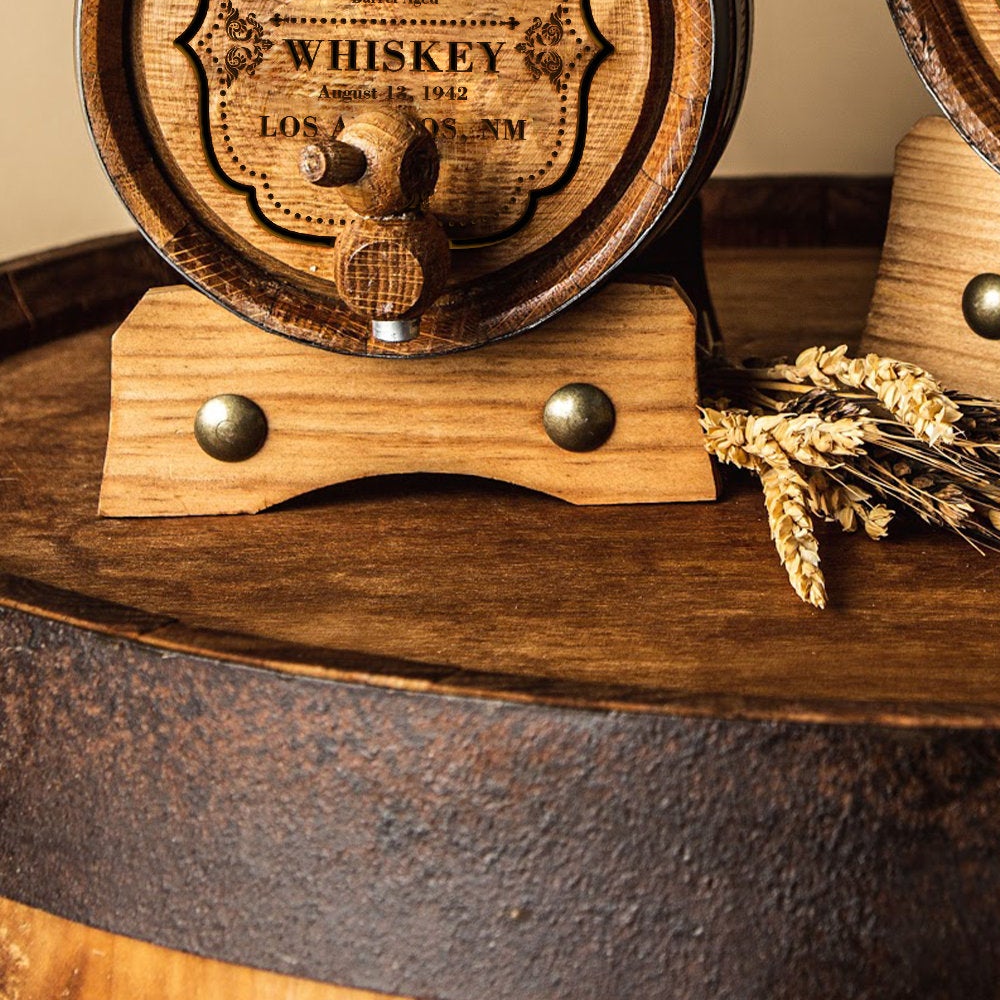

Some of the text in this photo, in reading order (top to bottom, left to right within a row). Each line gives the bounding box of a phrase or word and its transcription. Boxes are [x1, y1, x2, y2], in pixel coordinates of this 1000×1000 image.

[283, 38, 507, 73] WHISKEY
[317, 85, 378, 103] August
[422, 86, 468, 101] 1942
[259, 115, 527, 142] LOS AOS, NM
